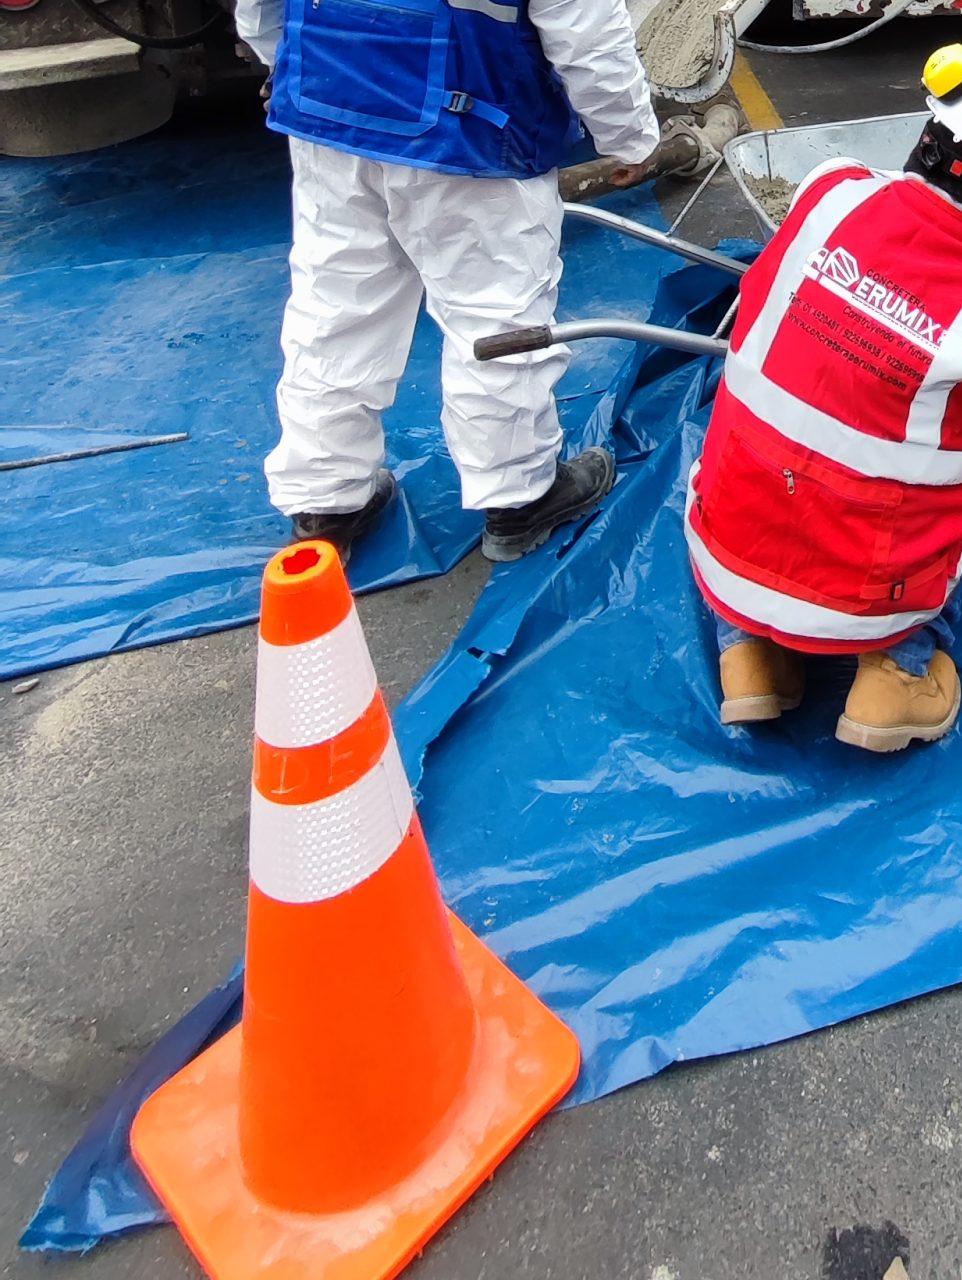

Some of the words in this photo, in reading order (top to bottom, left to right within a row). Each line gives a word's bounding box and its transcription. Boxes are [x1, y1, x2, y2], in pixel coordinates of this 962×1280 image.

[866, 268, 926, 312] CONCRETERA
[842, 306, 894, 343] Construyendo
[896, 338, 905, 347] el
[907, 345, 933, 366] futuro
